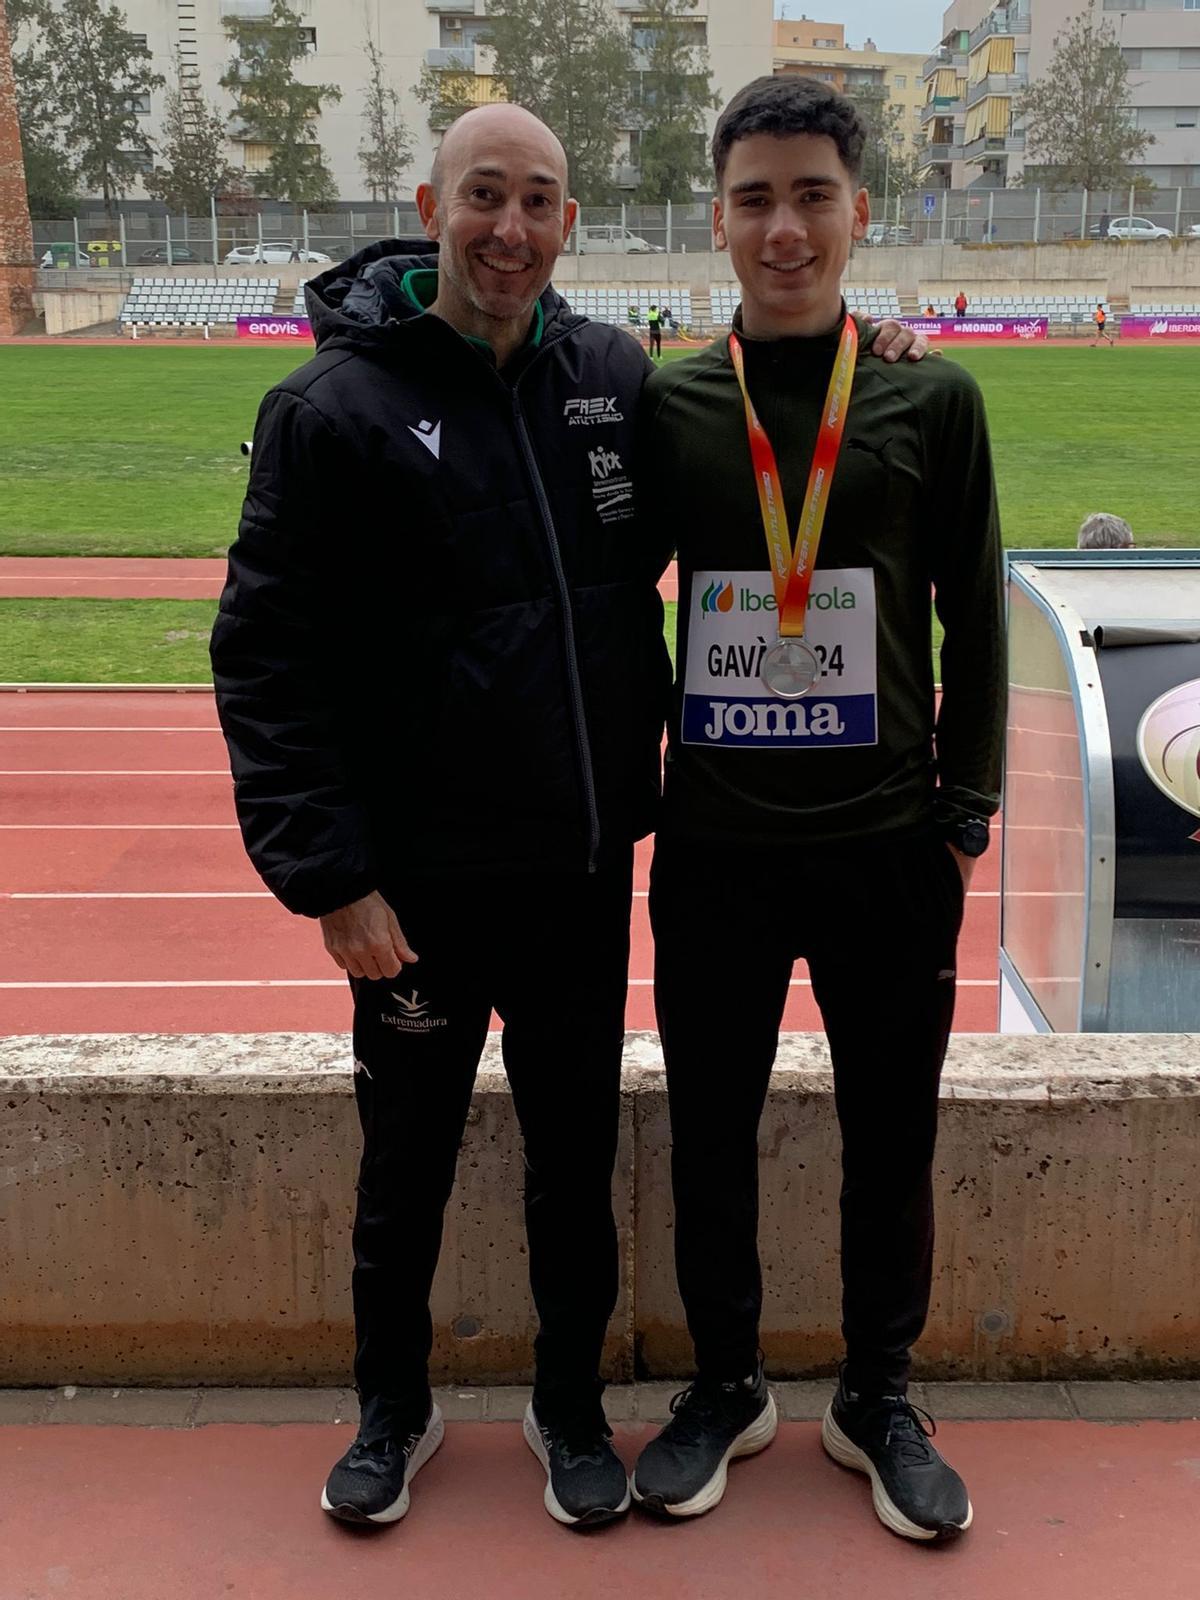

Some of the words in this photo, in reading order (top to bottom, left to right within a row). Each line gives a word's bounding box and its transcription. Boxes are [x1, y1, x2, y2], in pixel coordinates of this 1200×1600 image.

[249, 322, 299, 335] enovis
[962, 323, 1003, 333] MONDO
[564, 397, 617, 416] FAEX
[569, 412, 624, 425] ATLETISMO
[740, 587, 856, 612] Iberola
[381, 1014, 447, 1028] Extremadura
